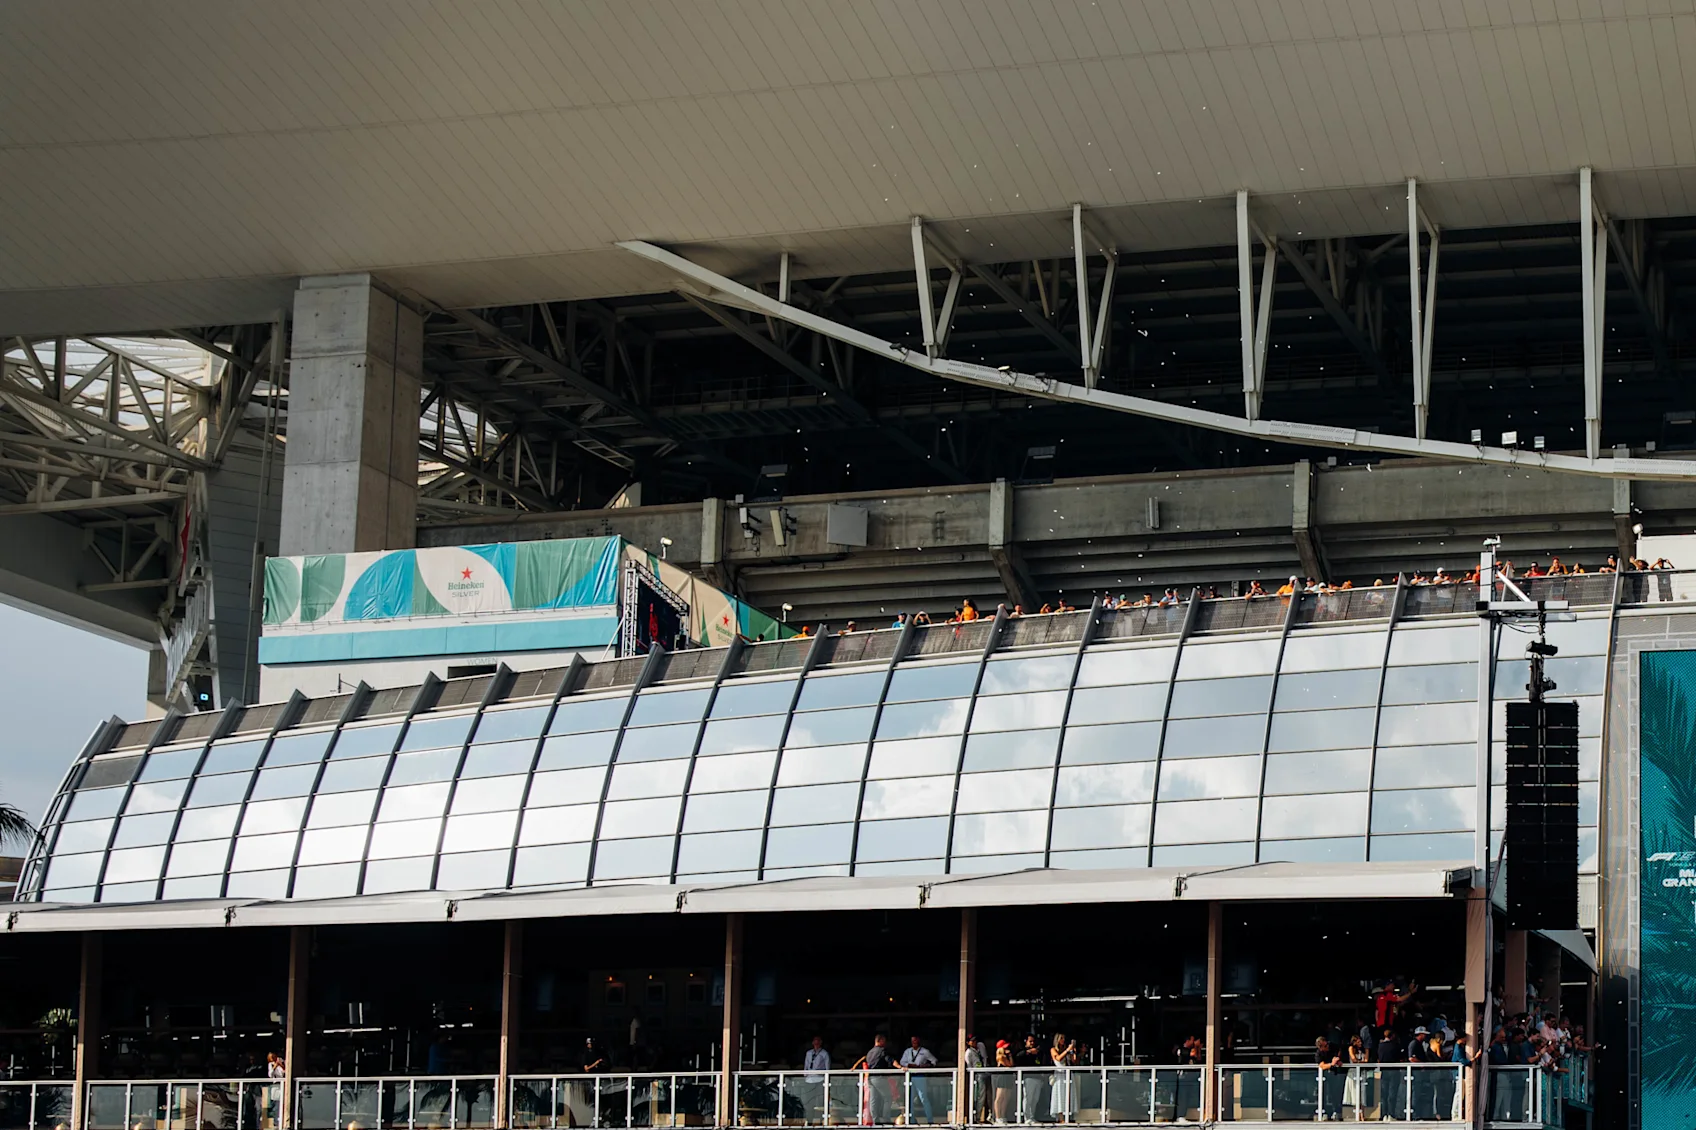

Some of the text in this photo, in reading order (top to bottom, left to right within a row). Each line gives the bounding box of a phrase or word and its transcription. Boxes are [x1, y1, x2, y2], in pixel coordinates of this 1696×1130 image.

[448, 580, 484, 590] Heineken
[452, 590, 480, 598] SILVER
[467, 657, 500, 666] WOMEN
